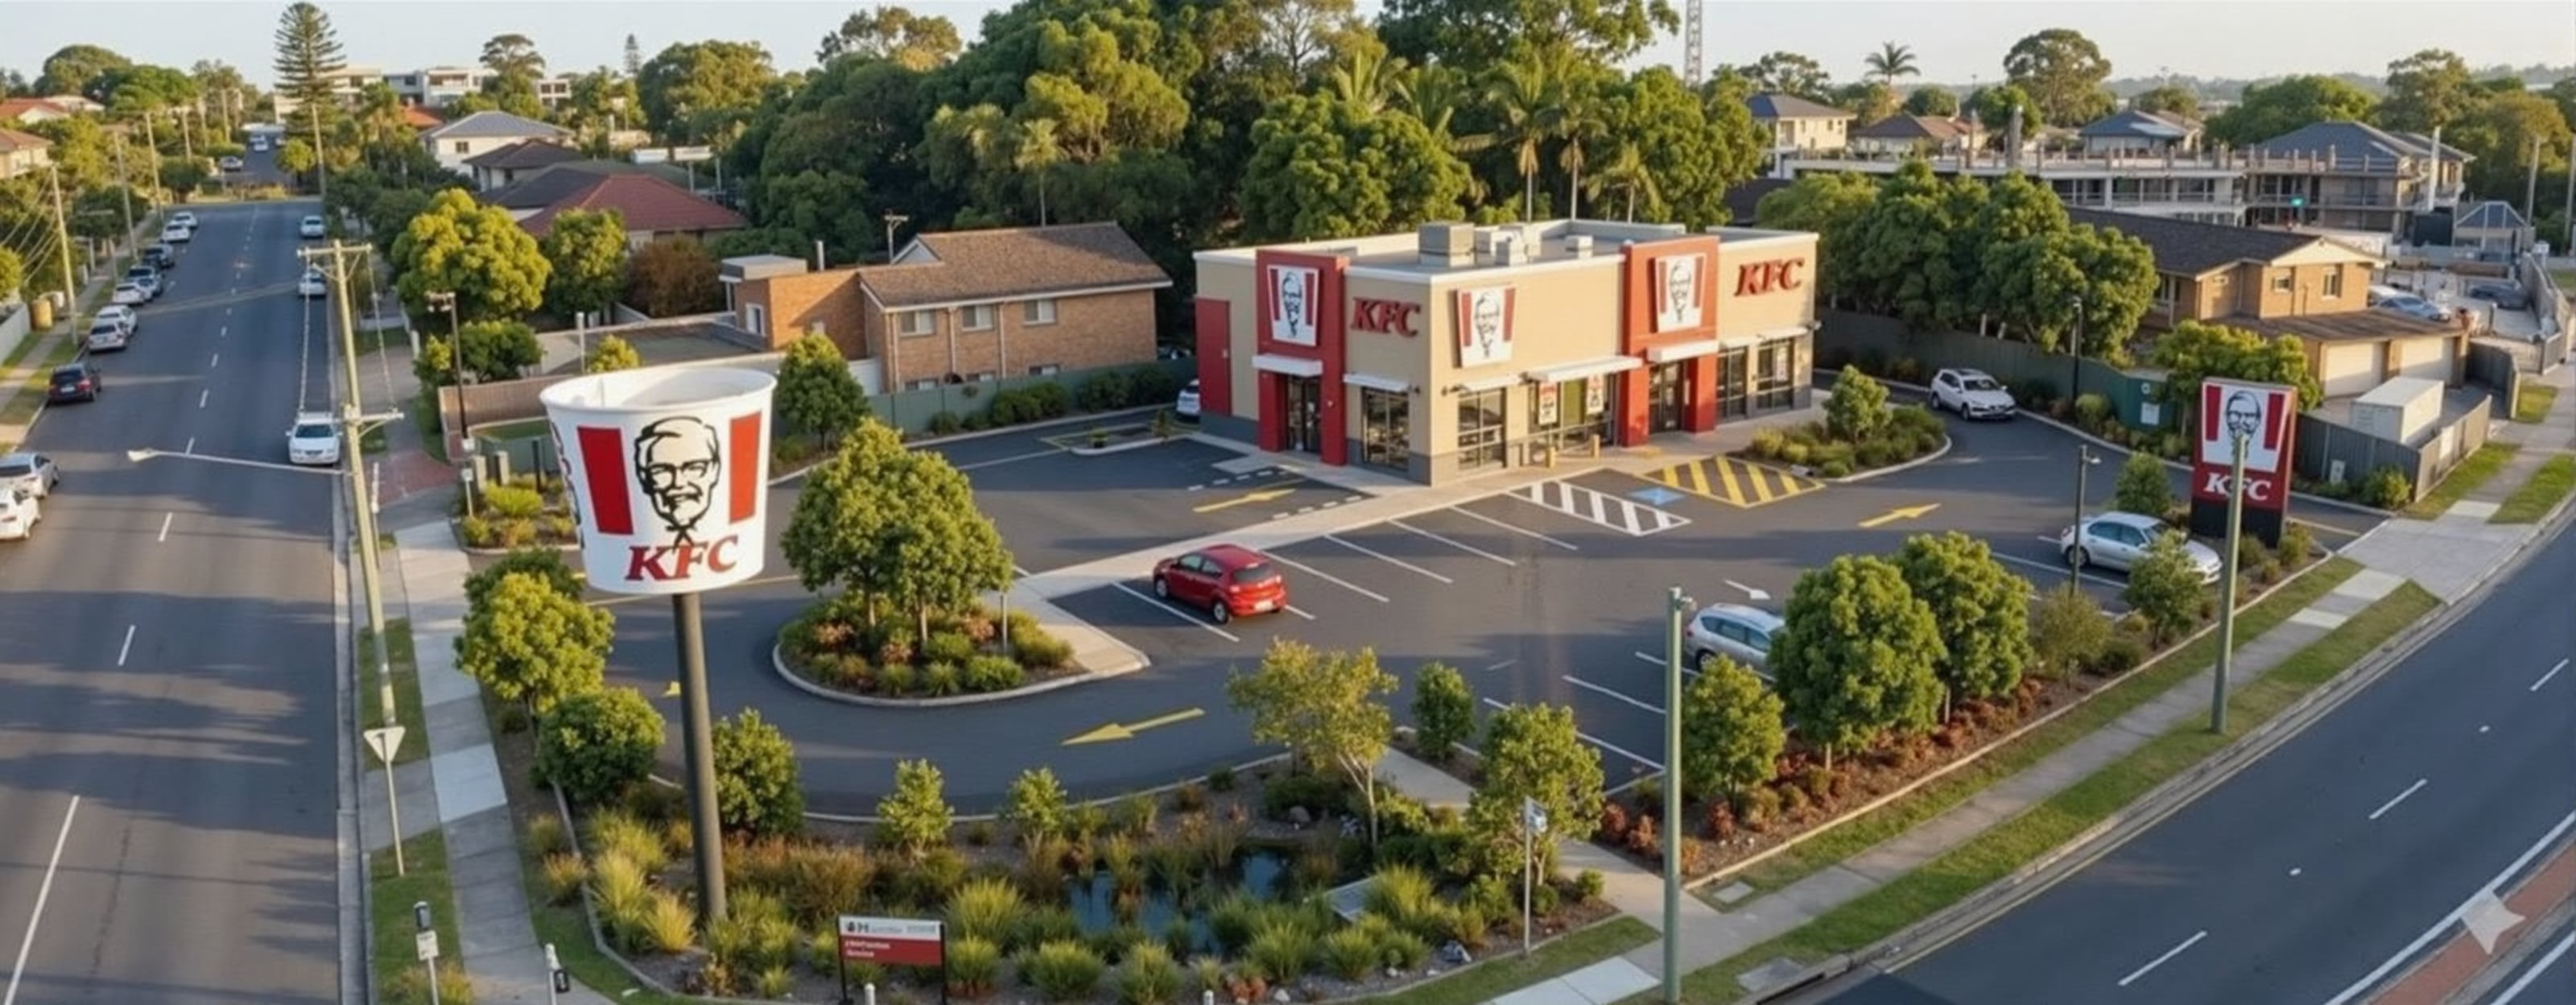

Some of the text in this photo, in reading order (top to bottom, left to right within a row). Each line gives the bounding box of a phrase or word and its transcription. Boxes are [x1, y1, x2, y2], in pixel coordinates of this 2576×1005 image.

[1735, 258, 1805, 297] KFC
[1351, 297, 1421, 337] KFC
[625, 536, 739, 581] KFC
